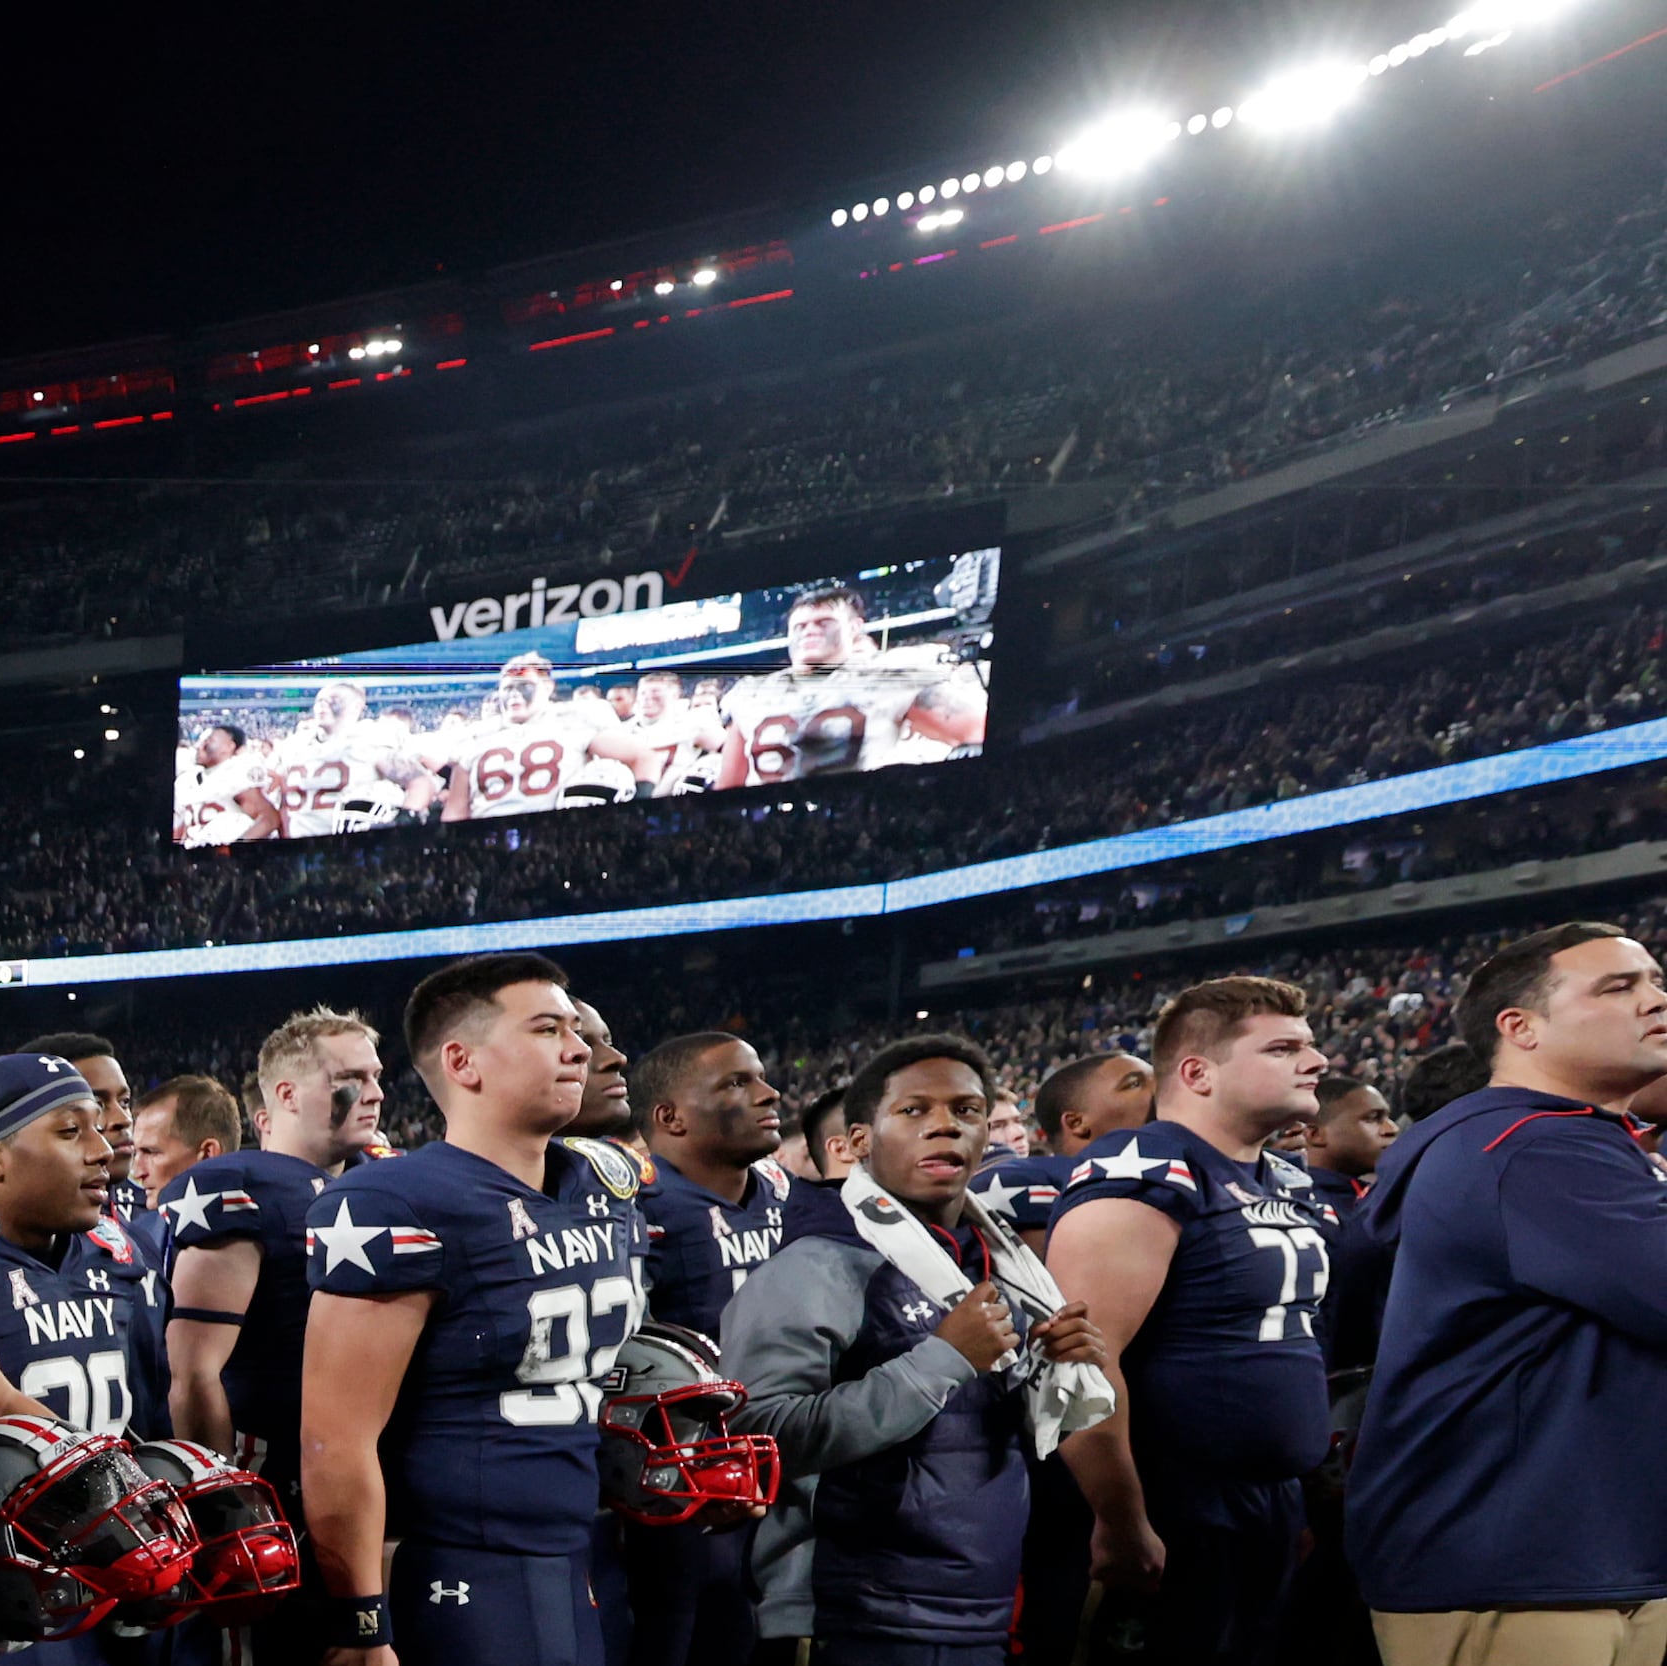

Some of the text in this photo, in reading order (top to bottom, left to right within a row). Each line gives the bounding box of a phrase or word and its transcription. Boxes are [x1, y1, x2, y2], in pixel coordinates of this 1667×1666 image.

[430, 570, 665, 642] verizon
[281, 760, 351, 812] 62
[477, 740, 565, 801] 68
[525, 1222, 616, 1277] NAVY
[718, 1227, 784, 1267] NAVY
[24, 1297, 115, 1346] NAVY
